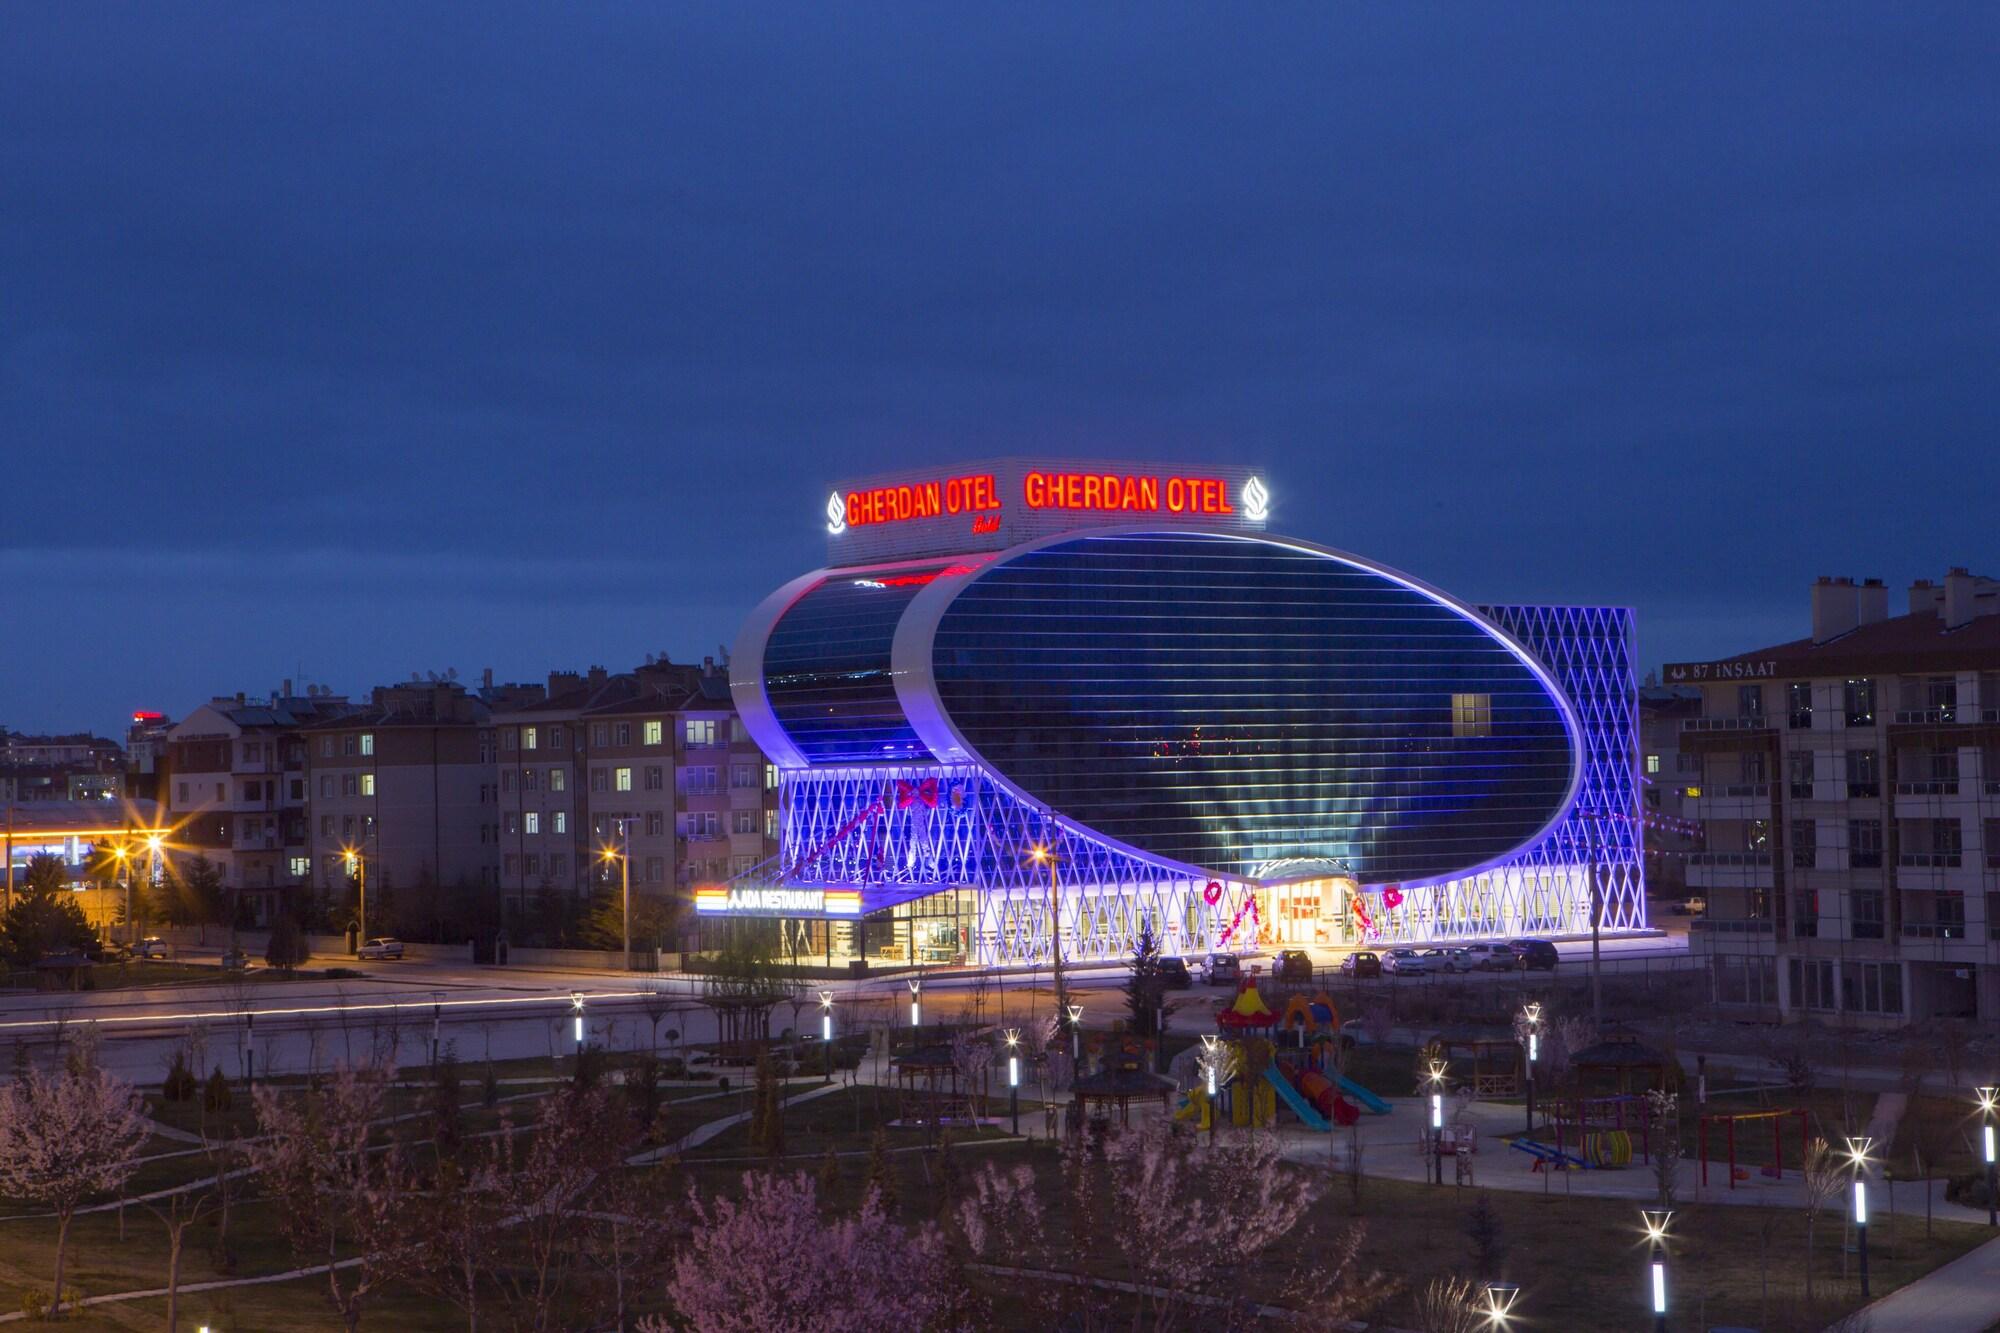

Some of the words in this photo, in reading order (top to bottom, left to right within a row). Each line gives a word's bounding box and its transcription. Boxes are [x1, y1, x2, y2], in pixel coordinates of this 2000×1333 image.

[846, 481, 941, 526] GHERDAN
[946, 475, 1001, 515] OTEL
[1025, 472, 1159, 511] GHERDAN
[1167, 477, 1233, 513] OTEL
[1693, 664, 1708, 678] 87
[761, 889, 825, 910] RESTAURANT
